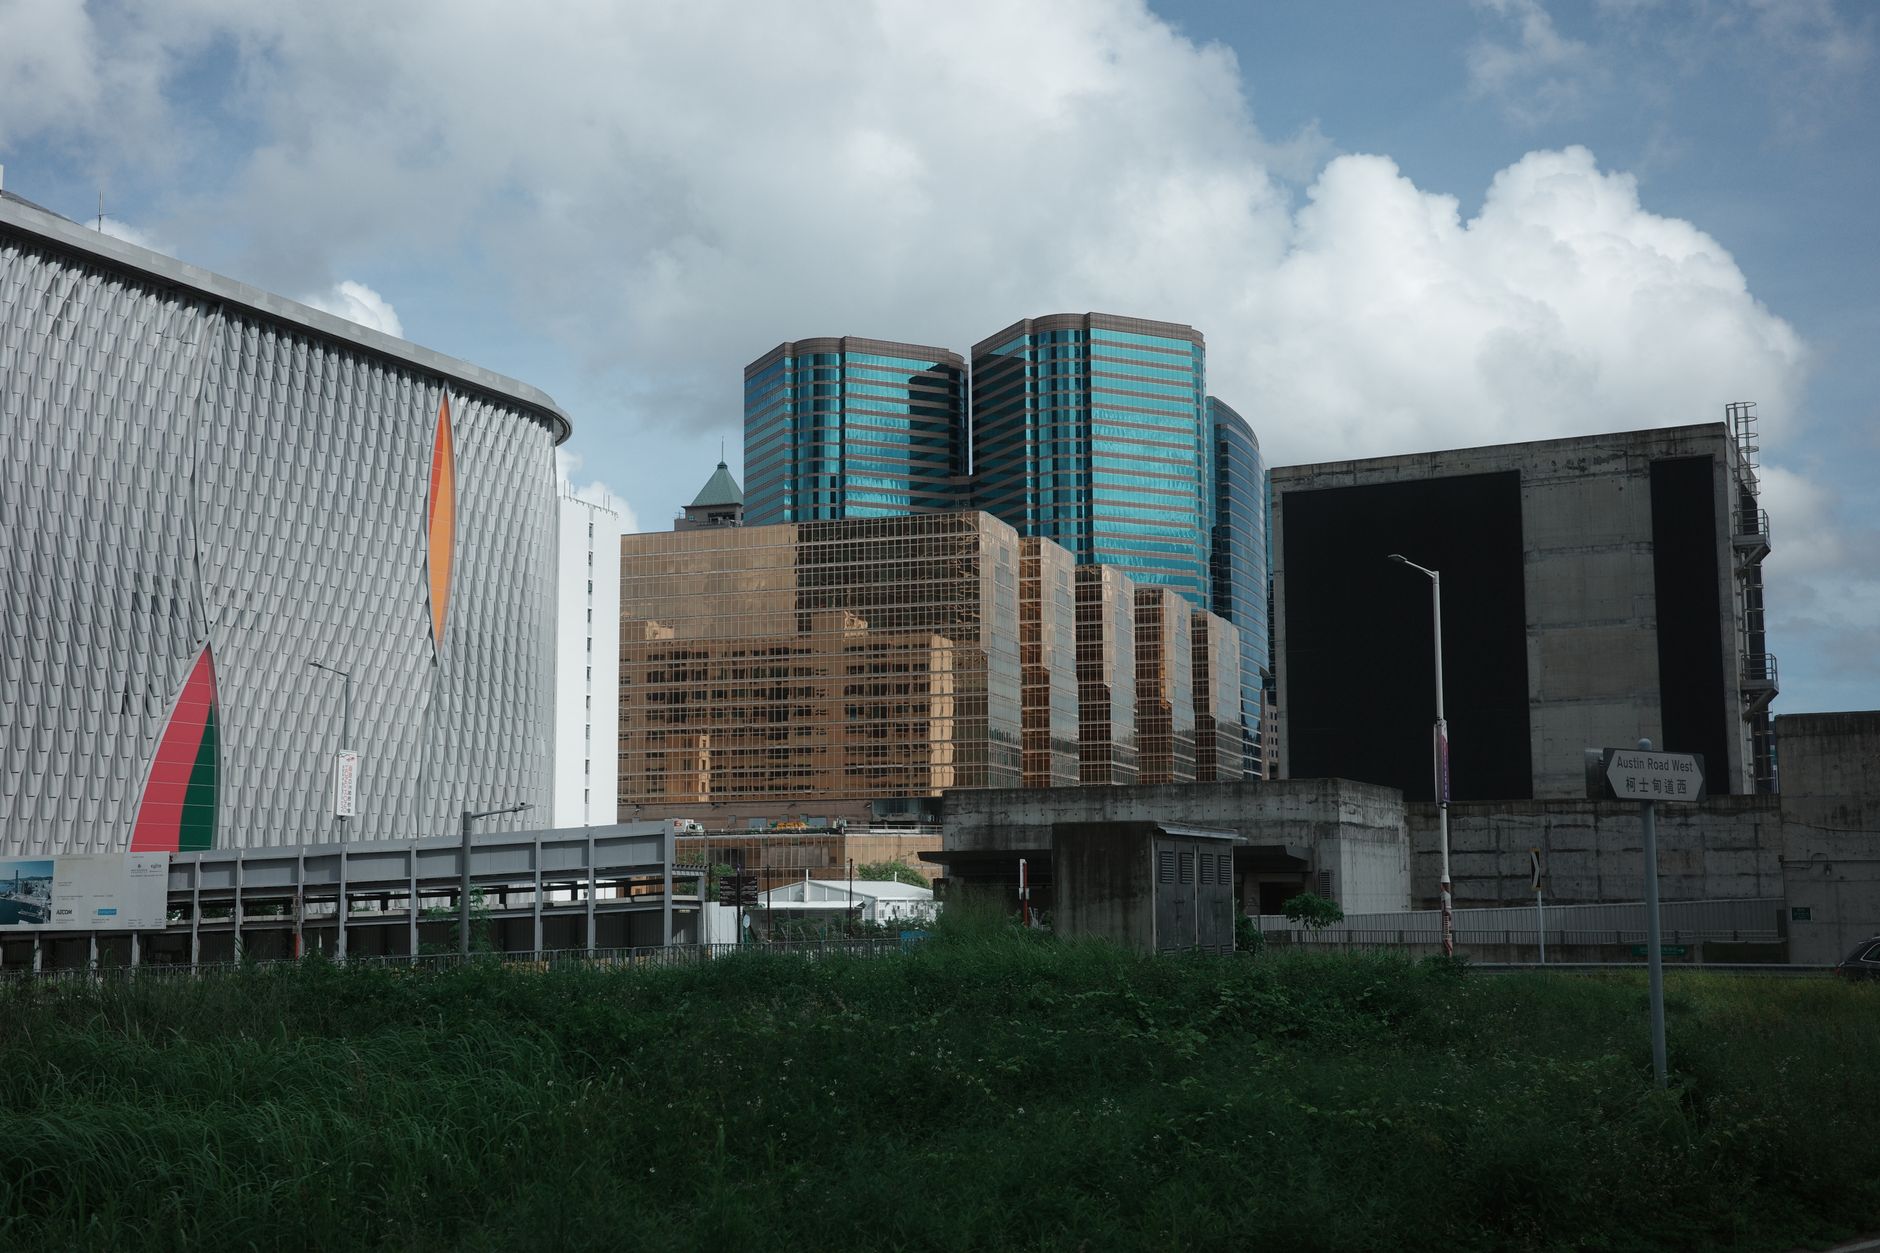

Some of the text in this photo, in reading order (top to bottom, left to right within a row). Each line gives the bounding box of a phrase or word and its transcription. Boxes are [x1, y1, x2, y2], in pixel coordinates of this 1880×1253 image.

[1617, 756, 1693, 773] Austin Road West
[1626, 776, 1687, 794] 柯士甸道西
